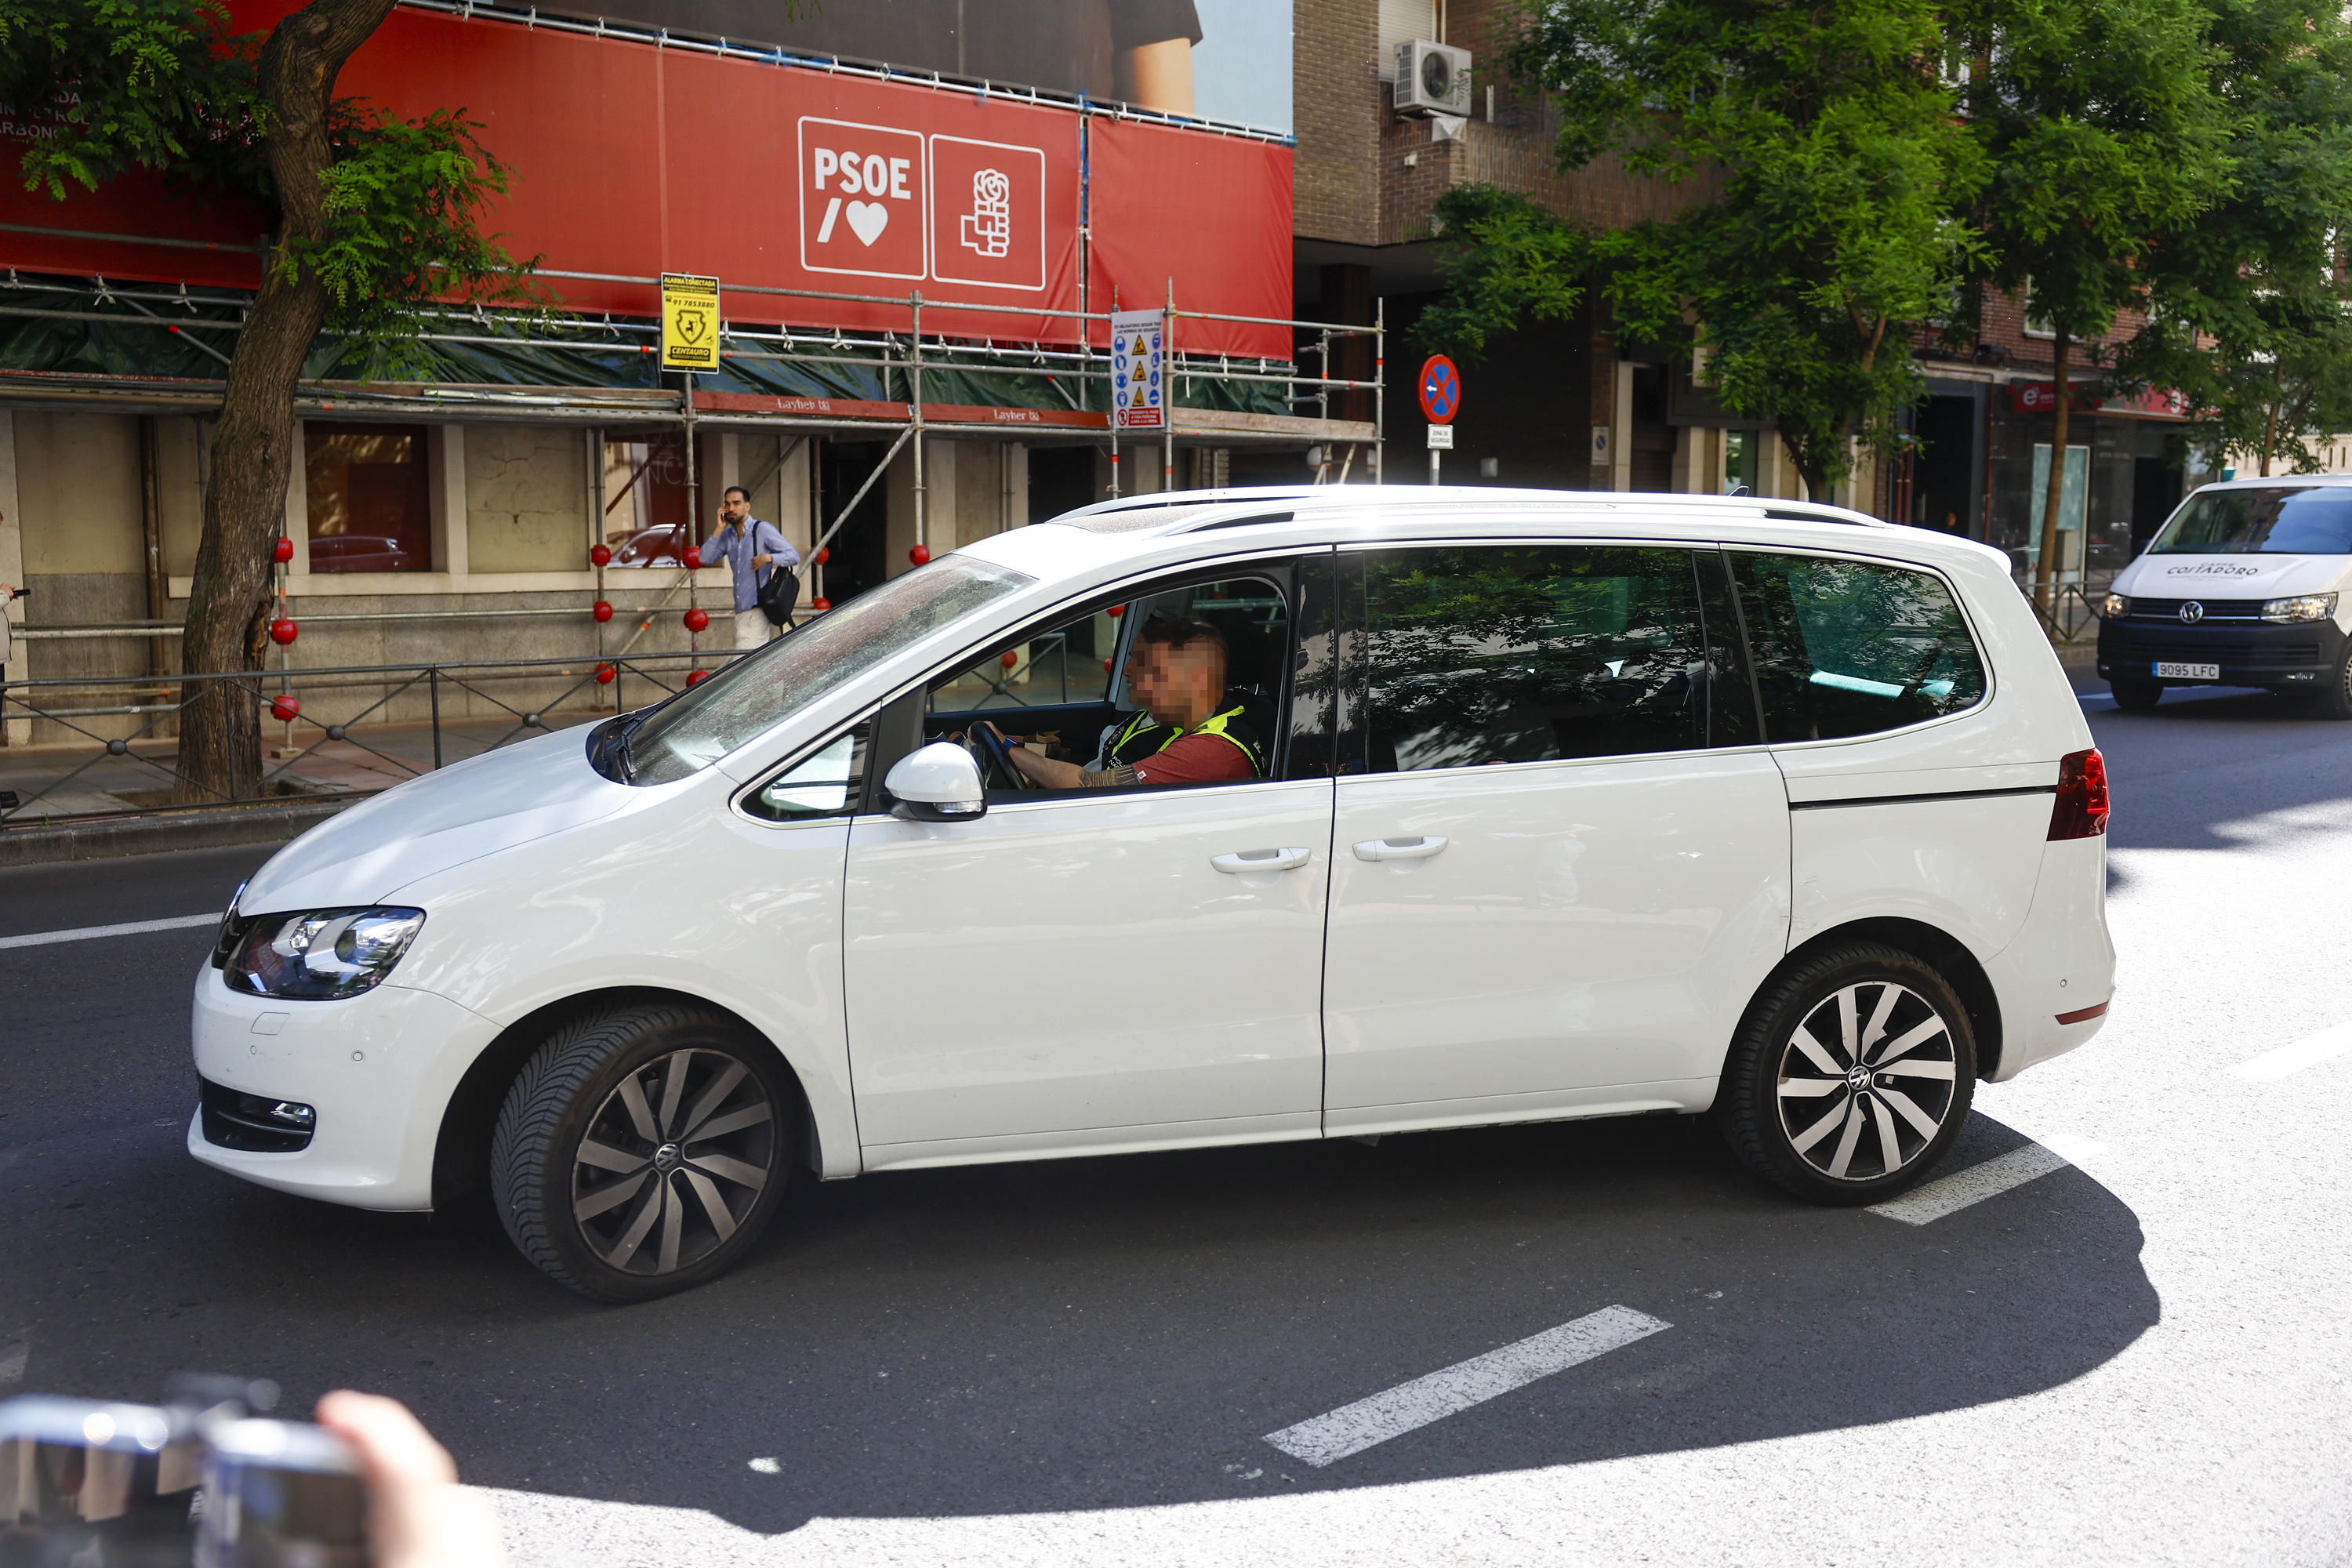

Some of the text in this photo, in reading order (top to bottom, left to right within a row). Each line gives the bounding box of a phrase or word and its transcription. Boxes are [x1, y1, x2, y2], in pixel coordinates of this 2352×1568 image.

[815, 147, 911, 200] PSOE
[672, 347, 710, 356] CENTAURO
[993, 408, 1026, 422] Layher
[2167, 566, 2258, 575] COSTADORO
[2160, 664, 2216, 677] 9095 LFC
